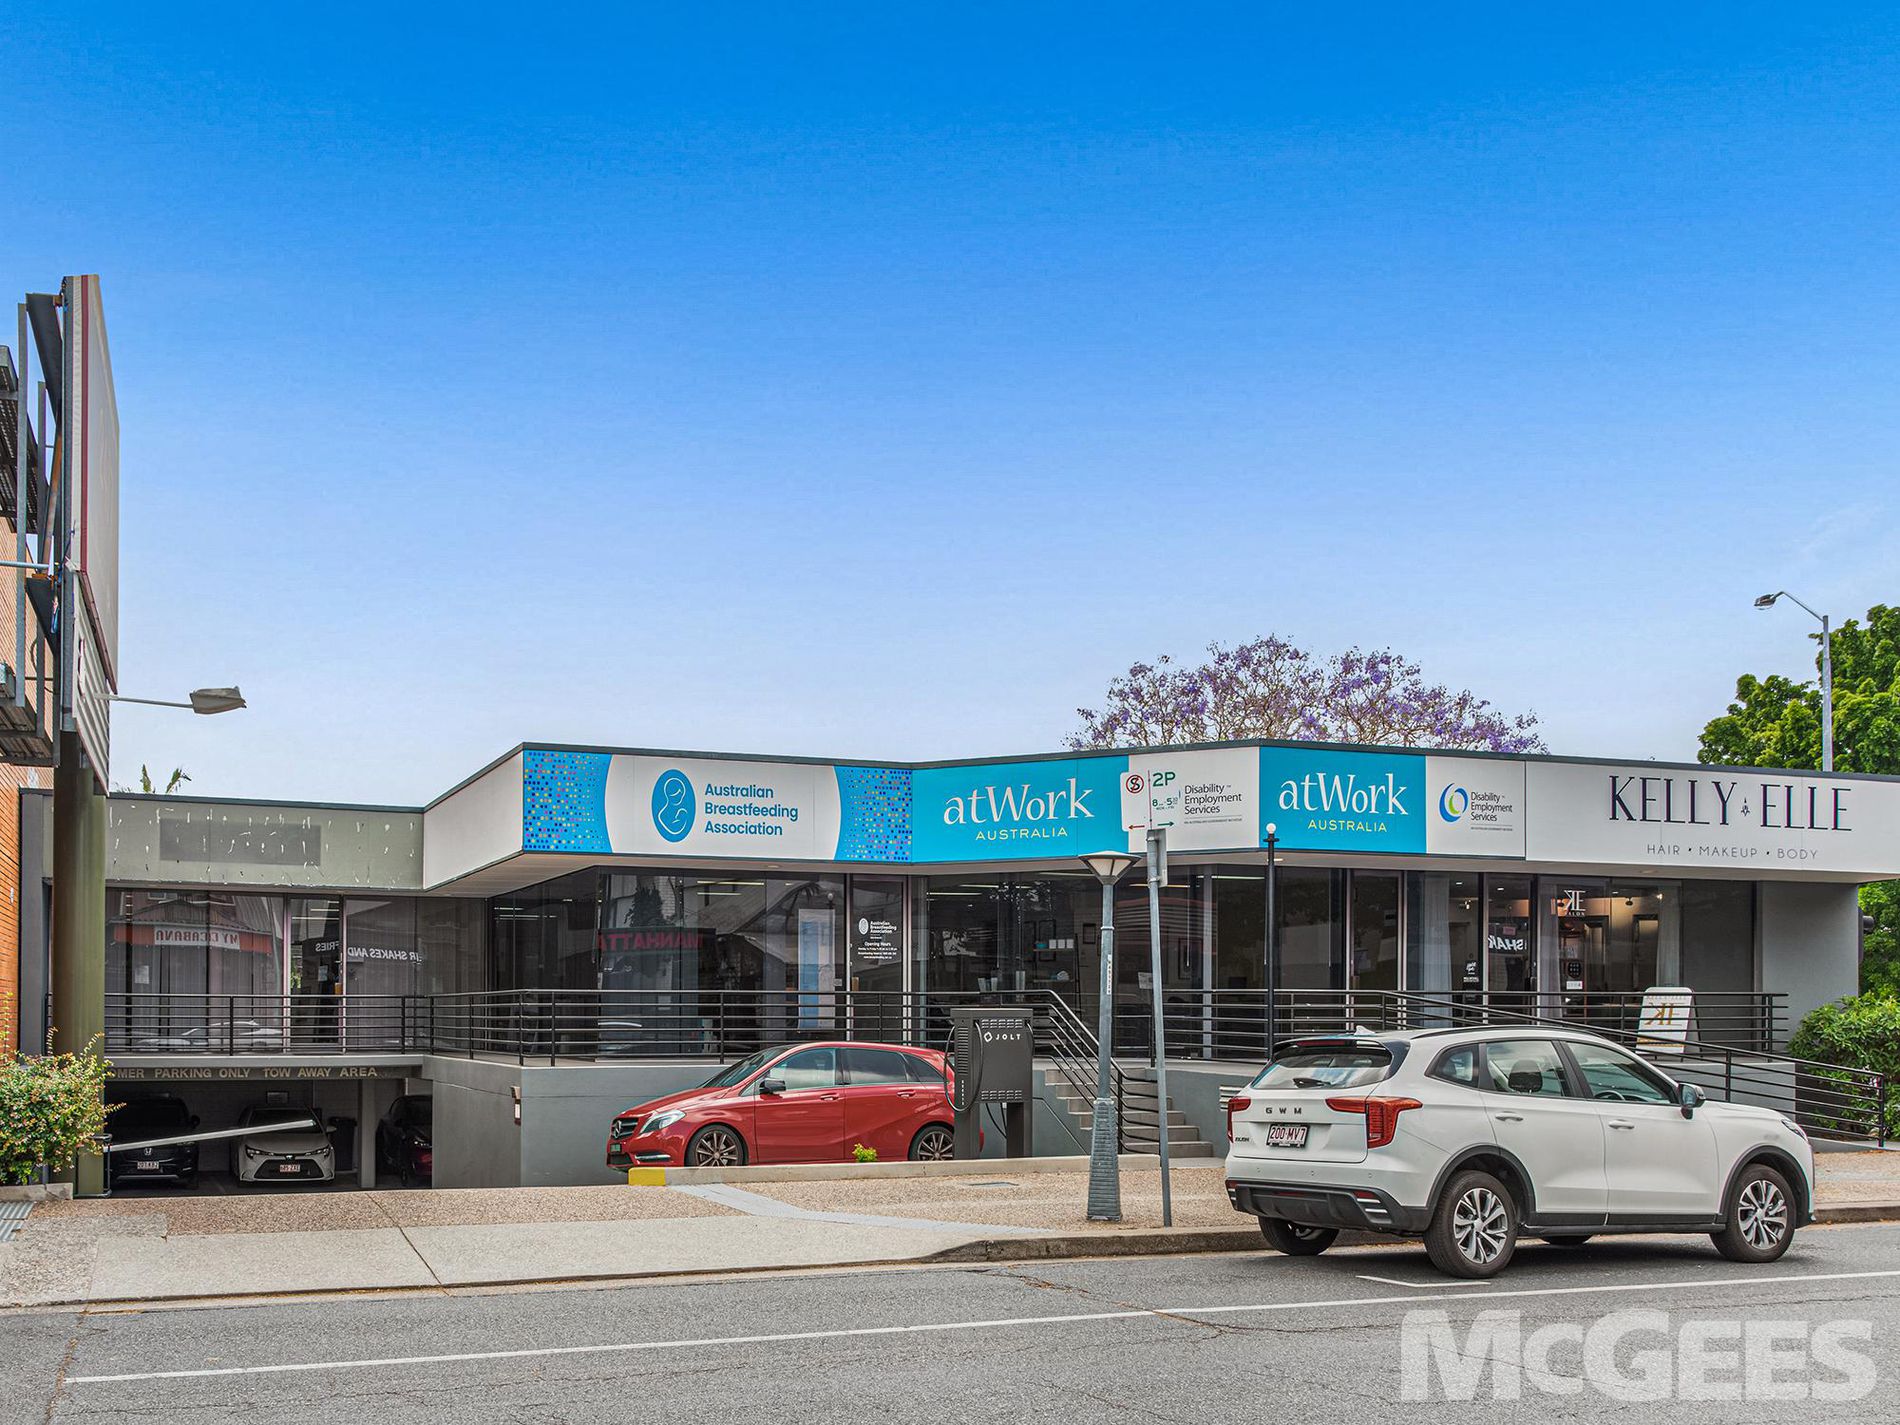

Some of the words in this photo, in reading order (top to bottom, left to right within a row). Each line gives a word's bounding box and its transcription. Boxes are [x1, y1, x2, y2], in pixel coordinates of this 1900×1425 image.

[1152, 771, 1176, 787] 2P
[704, 783, 774, 798] Australian
[1184, 783, 1225, 795] Disability
[1279, 772, 1408, 815] atWork
[943, 777, 1095, 825] atWork
[1184, 793, 1242, 805] Employment
[1471, 792, 1500, 803] Disability
[1609, 775, 1737, 826] KELLY
[1760, 783, 1852, 831] ELLE
[704, 802, 799, 822] Breastfeeding
[1184, 804, 1221, 814] Services
[1471, 801, 1513, 813] Employment
[1471, 811, 1498, 822] Services
[704, 820, 784, 836] Association
[975, 826, 1068, 841] AUSTRALIA
[1307, 819, 1388, 833] AUSTRALIA
[1646, 844, 1680, 856] HAIR
[1699, 845, 1758, 858] MAKEUP
[1777, 848, 1819, 860] BODY
[154, 1068, 212, 1078] PARKING
[219, 1068, 251, 1078] ONLY
[263, 1067, 291, 1078] TOW
[297, 1067, 332, 1078] AWAY
[339, 1067, 378, 1077] AREA
